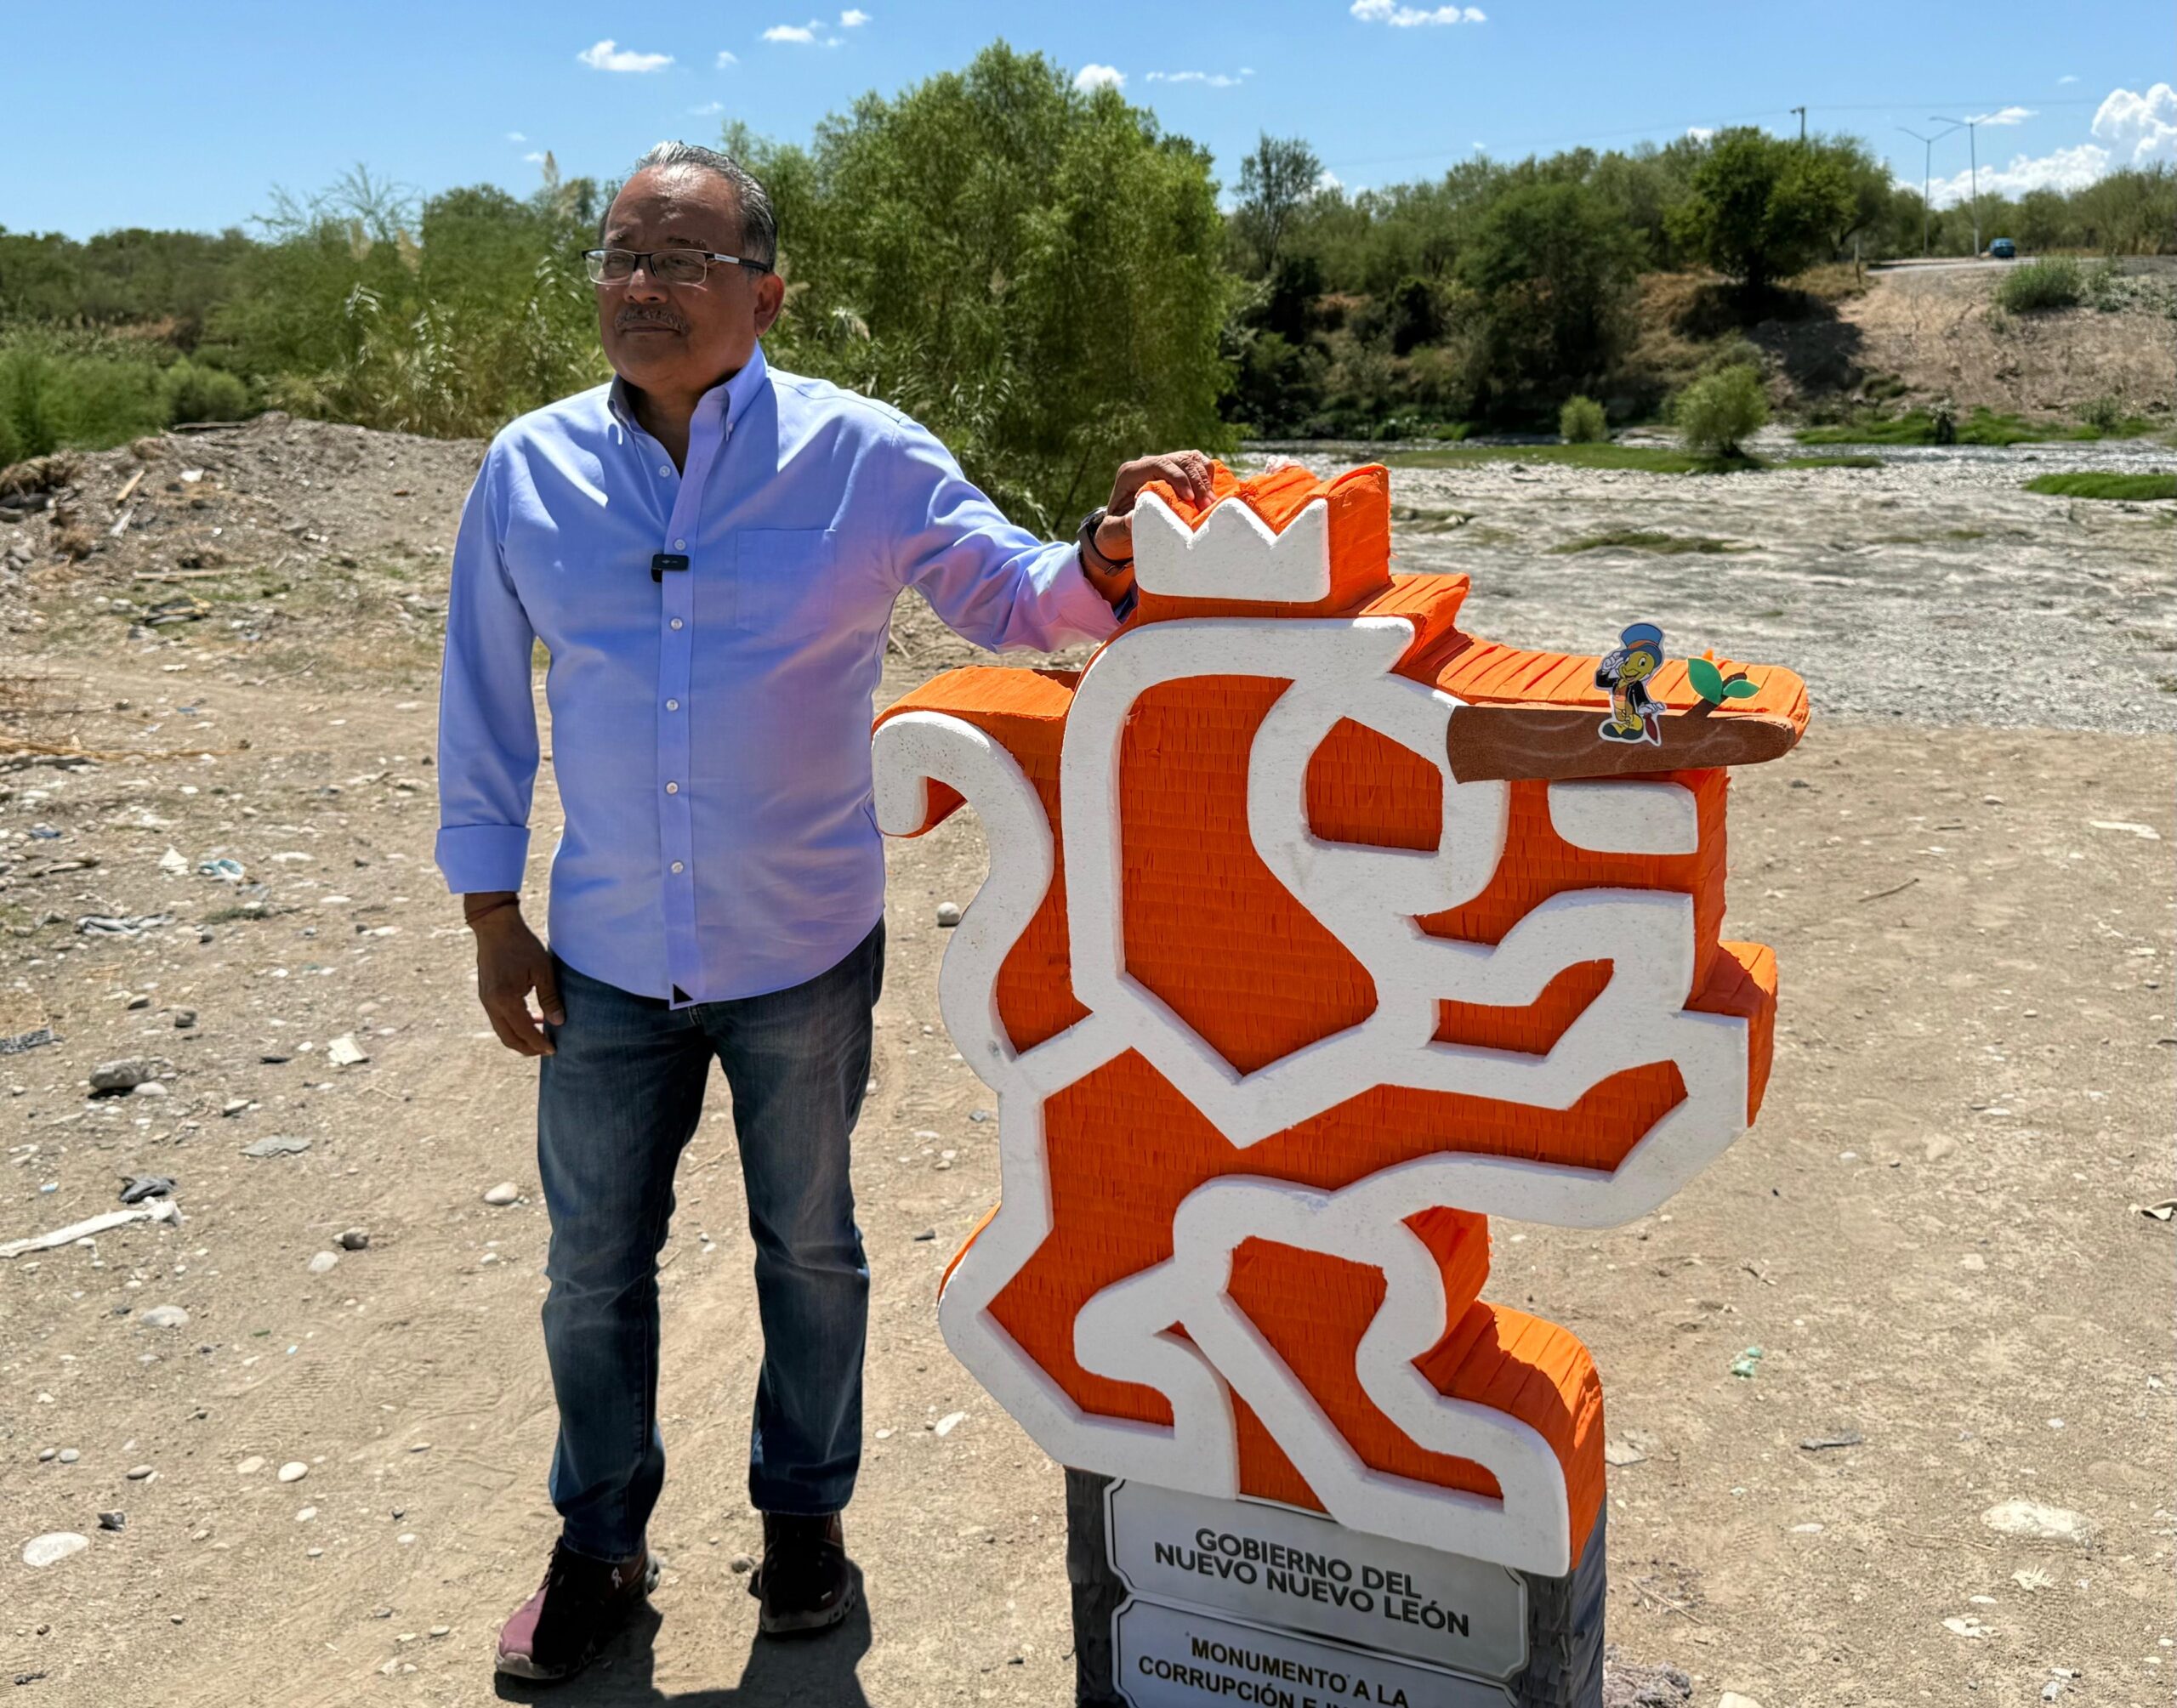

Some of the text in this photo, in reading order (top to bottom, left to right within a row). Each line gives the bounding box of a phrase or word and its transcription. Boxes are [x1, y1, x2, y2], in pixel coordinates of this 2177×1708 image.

[1154, 1541, 1469, 1637] NUEVO NUEVO LEÓN
[1195, 1528, 1423, 1600] GOBIERNO DEL
[1138, 1655, 1294, 1708] CORRUPCIÓN
[1352, 1679, 1371, 1701] A
[1377, 1683, 1410, 1708] LA
